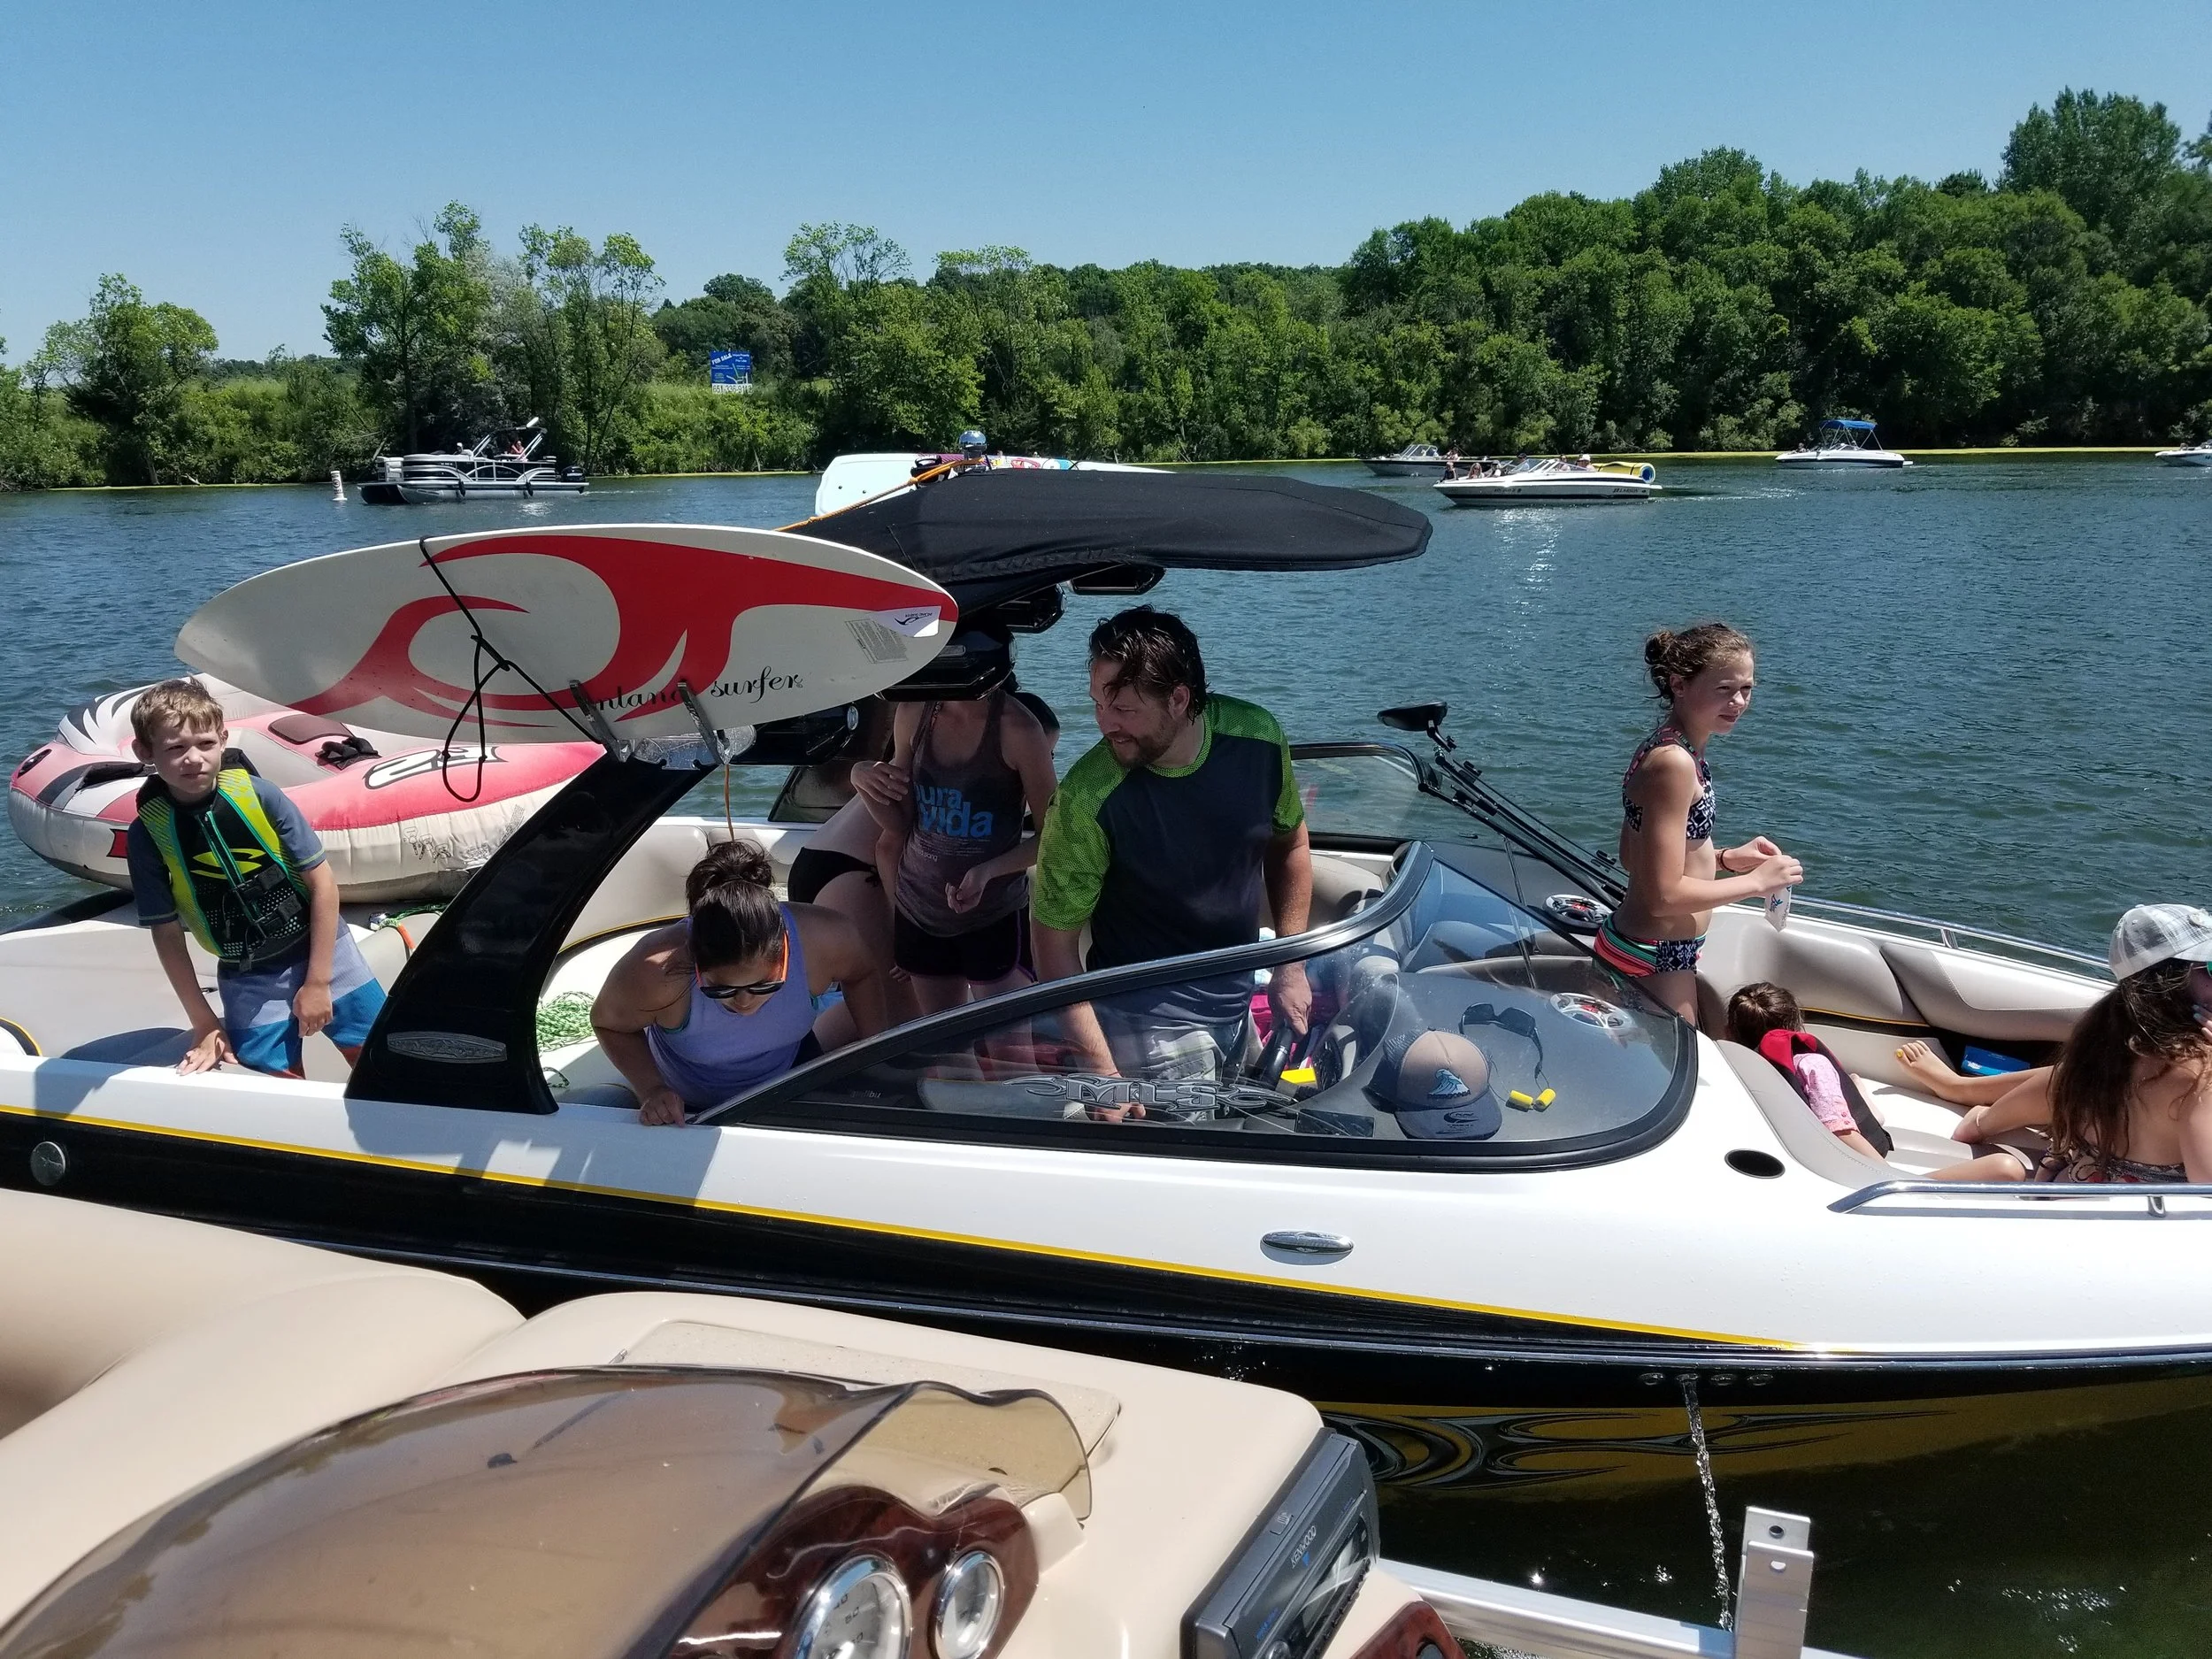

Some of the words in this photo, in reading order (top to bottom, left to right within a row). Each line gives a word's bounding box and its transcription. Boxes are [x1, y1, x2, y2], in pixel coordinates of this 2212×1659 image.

[591, 686, 689, 711] nlan
[710, 665, 800, 704] surfer
[918, 801, 994, 838] vida
[1290, 1525, 1317, 1570] KENWOOD
